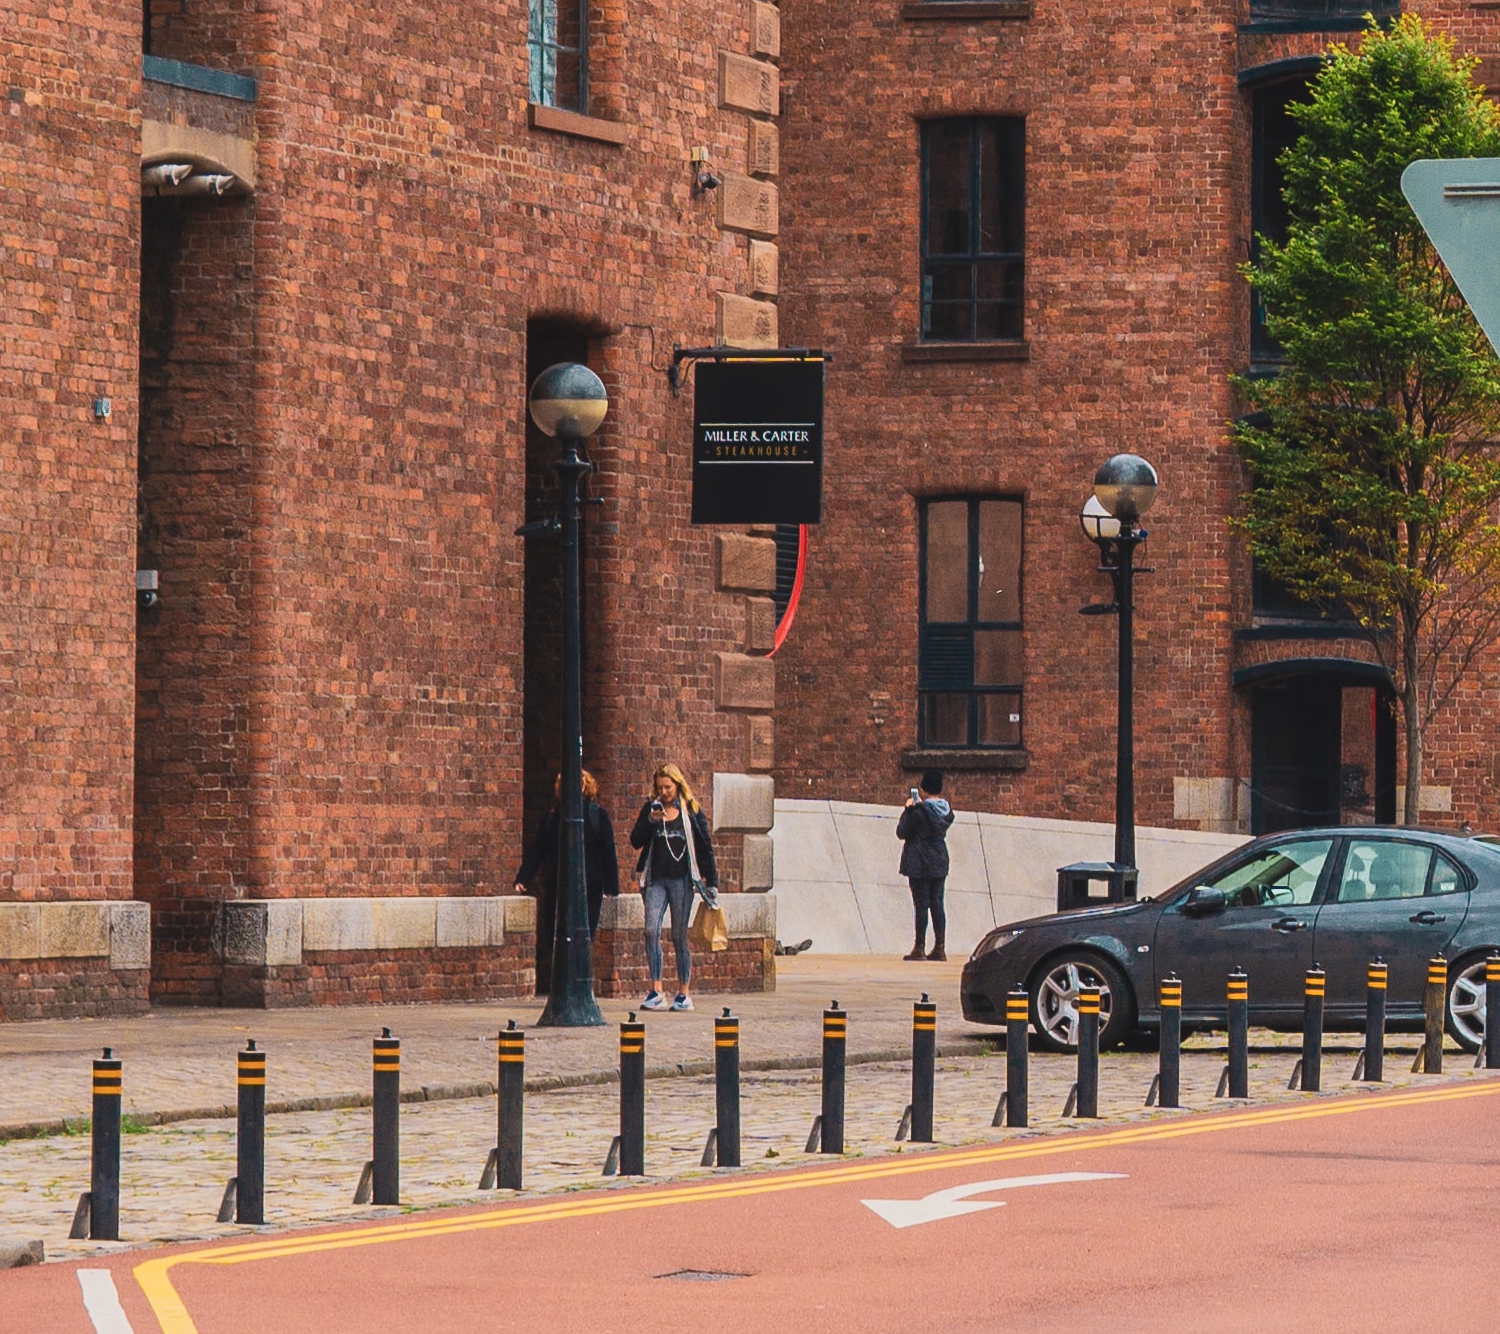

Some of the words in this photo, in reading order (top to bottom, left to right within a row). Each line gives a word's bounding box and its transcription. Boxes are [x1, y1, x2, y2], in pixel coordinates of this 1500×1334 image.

[704, 430, 748, 442] MILLER
[750, 430, 761, 442] &
[762, 430, 810, 442] CARTER
[715, 445, 798, 456] STEAKHOUSE
